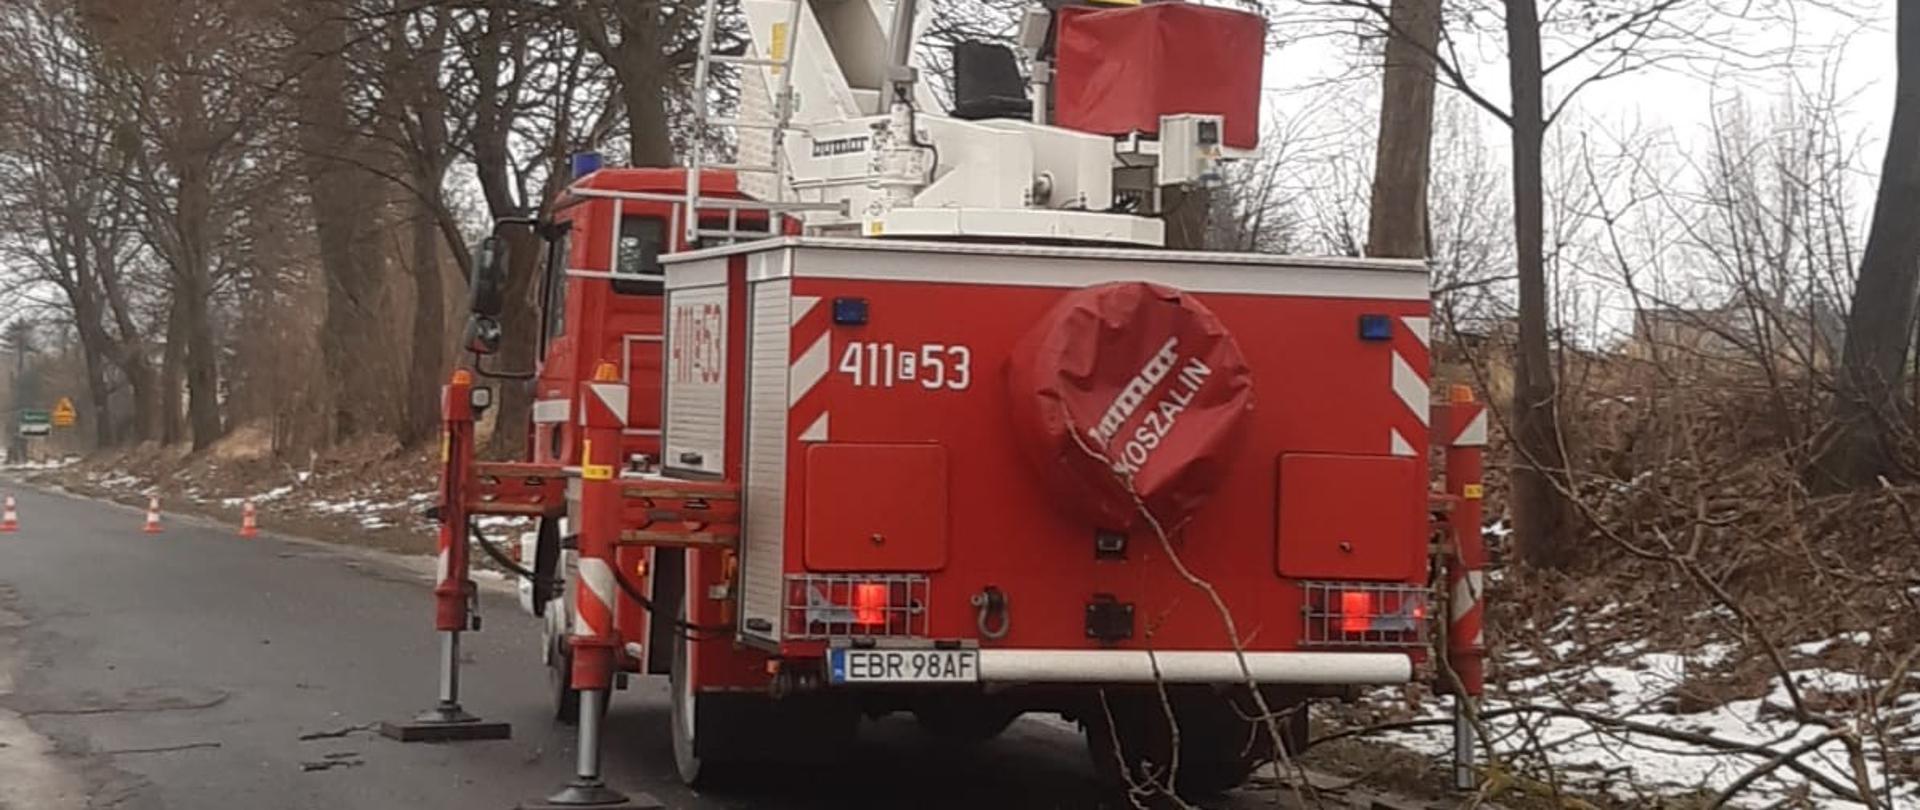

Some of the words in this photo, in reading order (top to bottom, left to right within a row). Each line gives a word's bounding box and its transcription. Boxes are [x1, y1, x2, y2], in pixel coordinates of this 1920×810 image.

[1114, 357, 1212, 472] KOSZALIN
[850, 652, 904, 678] EBR
[912, 652, 973, 678] 98AF
